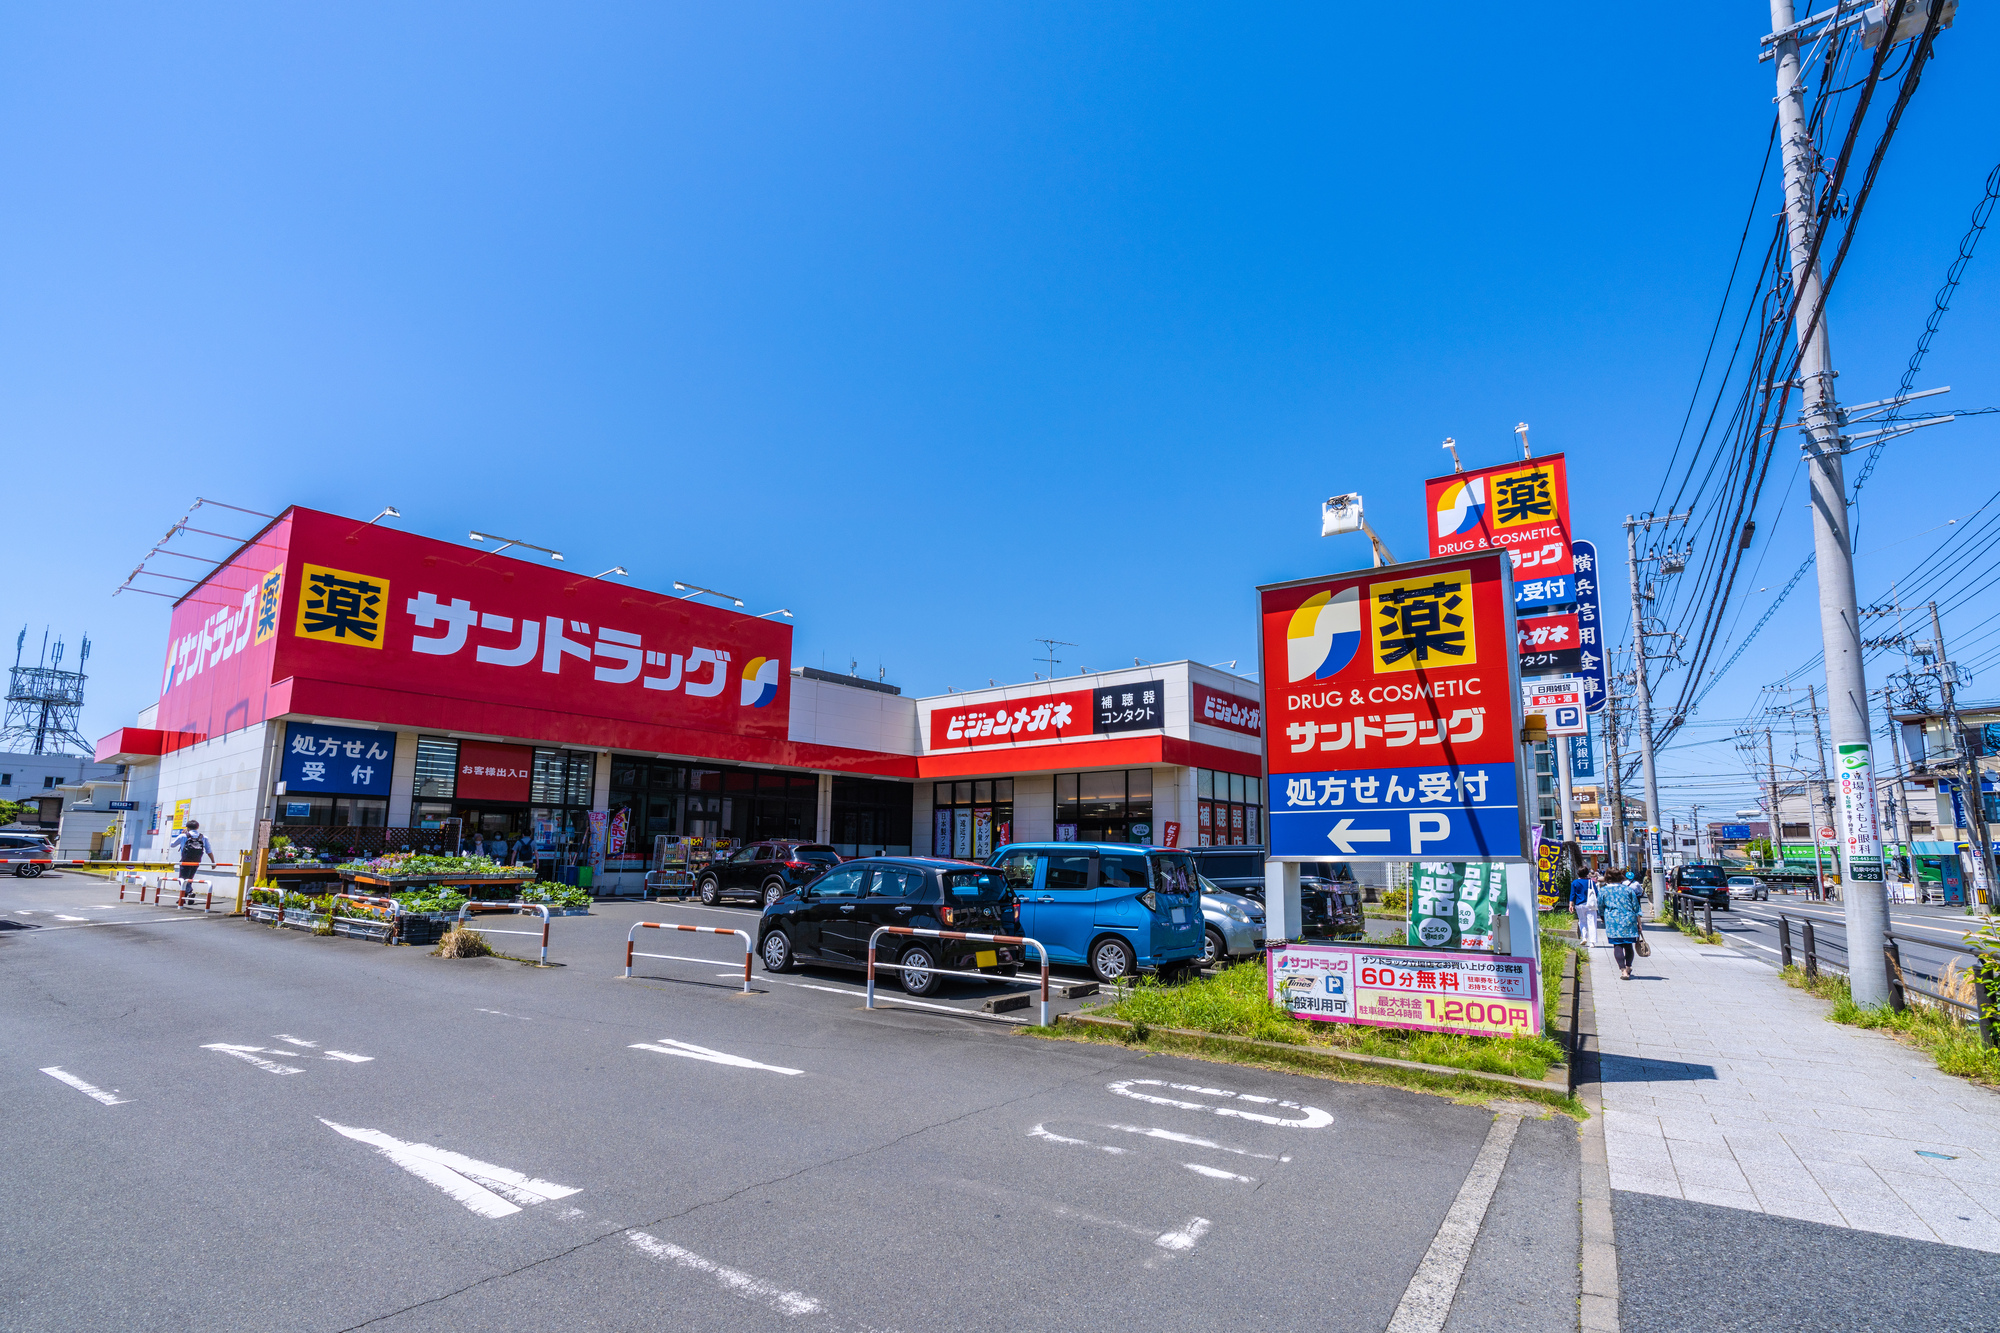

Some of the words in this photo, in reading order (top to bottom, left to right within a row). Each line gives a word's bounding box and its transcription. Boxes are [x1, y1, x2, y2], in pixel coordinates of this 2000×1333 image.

[1496, 472, 1552, 524] 薬
[1438, 540, 1475, 554] DRUG
[1479, 538, 1488, 547] &
[1491, 526, 1561, 546] COSMETIC
[1511, 542, 1564, 569] ラッグ
[176, 583, 259, 687] サンドラッグ
[257, 572, 281, 639] 薬
[303, 573, 382, 642] 薬
[406, 590, 732, 698] サンドラッグ
[1378, 581, 1466, 665] 薬
[1288, 691, 1343, 710] DRUG
[1350, 688, 1365, 705] &
[1368, 678, 1482, 704] COSMETIC
[1538, 684, 1571, 693] 日用雑貨
[946, 701, 1073, 740] ビジョンメガネ
[1101, 707, 1155, 724] コンタクト
[1286, 706, 1486, 753] サンドラッグ
[291, 734, 388, 760] 処方せん
[1575, 736, 1589, 770] 浜銀行
[462, 765, 528, 779] お客様出入口
[1286, 770, 1489, 807] 処方せん受付
[1573, 792, 1590, 802] ria
[1166, 825, 1177, 847] ビジョ
[1409, 812, 1451, 854] P
[1289, 956, 1348, 971] サンドラッグ
[1287, 978, 1312, 988] Times
[1328, 977, 1341, 992] P
[1361, 968, 1460, 991] 60分無料
[1468, 983, 1514, 993] お持ちください
[1359, 1006, 1423, 1020] 駐車後24時間
[1378, 996, 1422, 1009] 最大料金
[1425, 999, 1528, 1028] 1,200円
